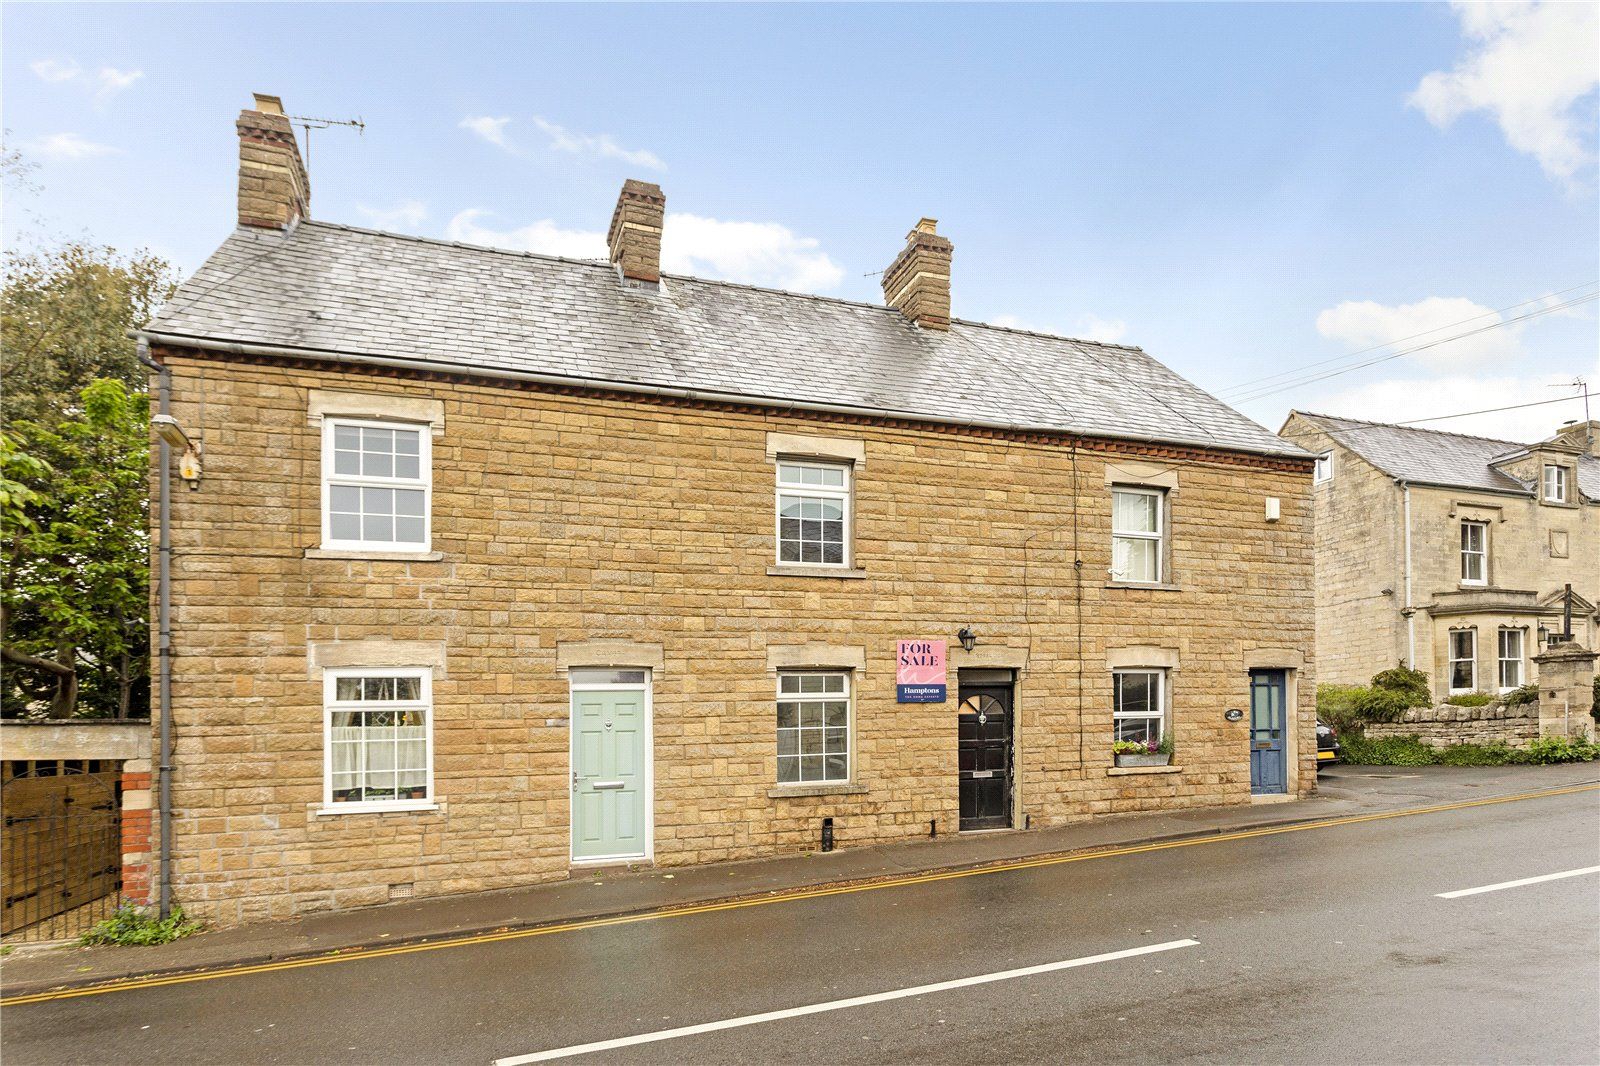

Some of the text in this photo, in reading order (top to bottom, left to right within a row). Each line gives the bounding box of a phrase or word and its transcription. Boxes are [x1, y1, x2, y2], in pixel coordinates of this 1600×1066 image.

[901, 643, 931, 654] FOR
[900, 655, 939, 666] SALE
[904, 687, 940, 695] Hamptons
